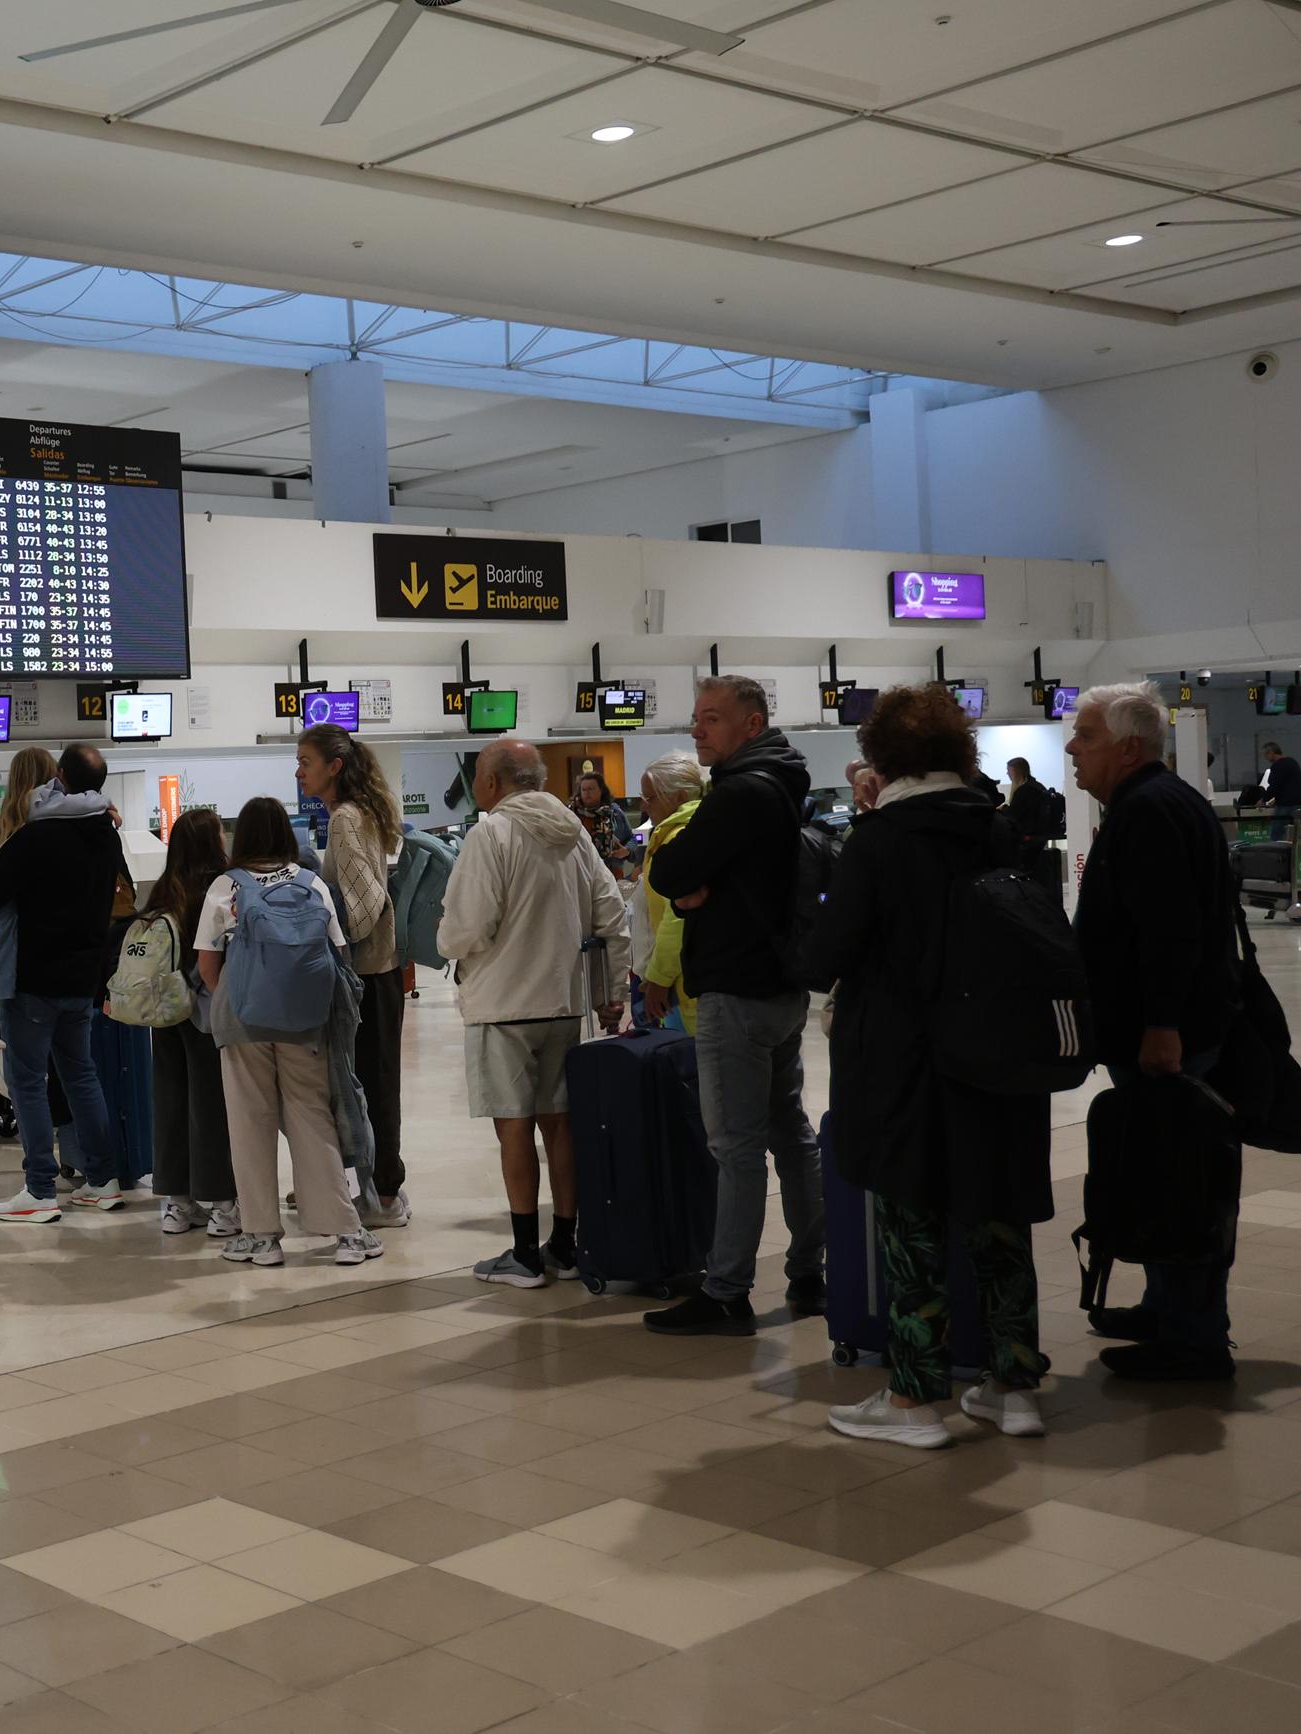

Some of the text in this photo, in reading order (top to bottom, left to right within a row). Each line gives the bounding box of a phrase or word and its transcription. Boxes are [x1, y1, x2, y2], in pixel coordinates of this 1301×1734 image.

[29, 424, 72, 437] Departures
[29, 435, 61, 448] Abflüge
[30, 447, 65, 459] Salidas
[486, 564, 544, 588] Boarding
[486, 590, 559, 612] Embarque
[580, 692, 593, 709] 15
[824, 691, 836, 705] 17
[1180, 687, 1191, 700] 20
[1248, 687, 1258, 700] 21
[82, 697, 102, 716] 12
[279, 695, 297, 713] 13
[446, 694, 462, 710] 14
